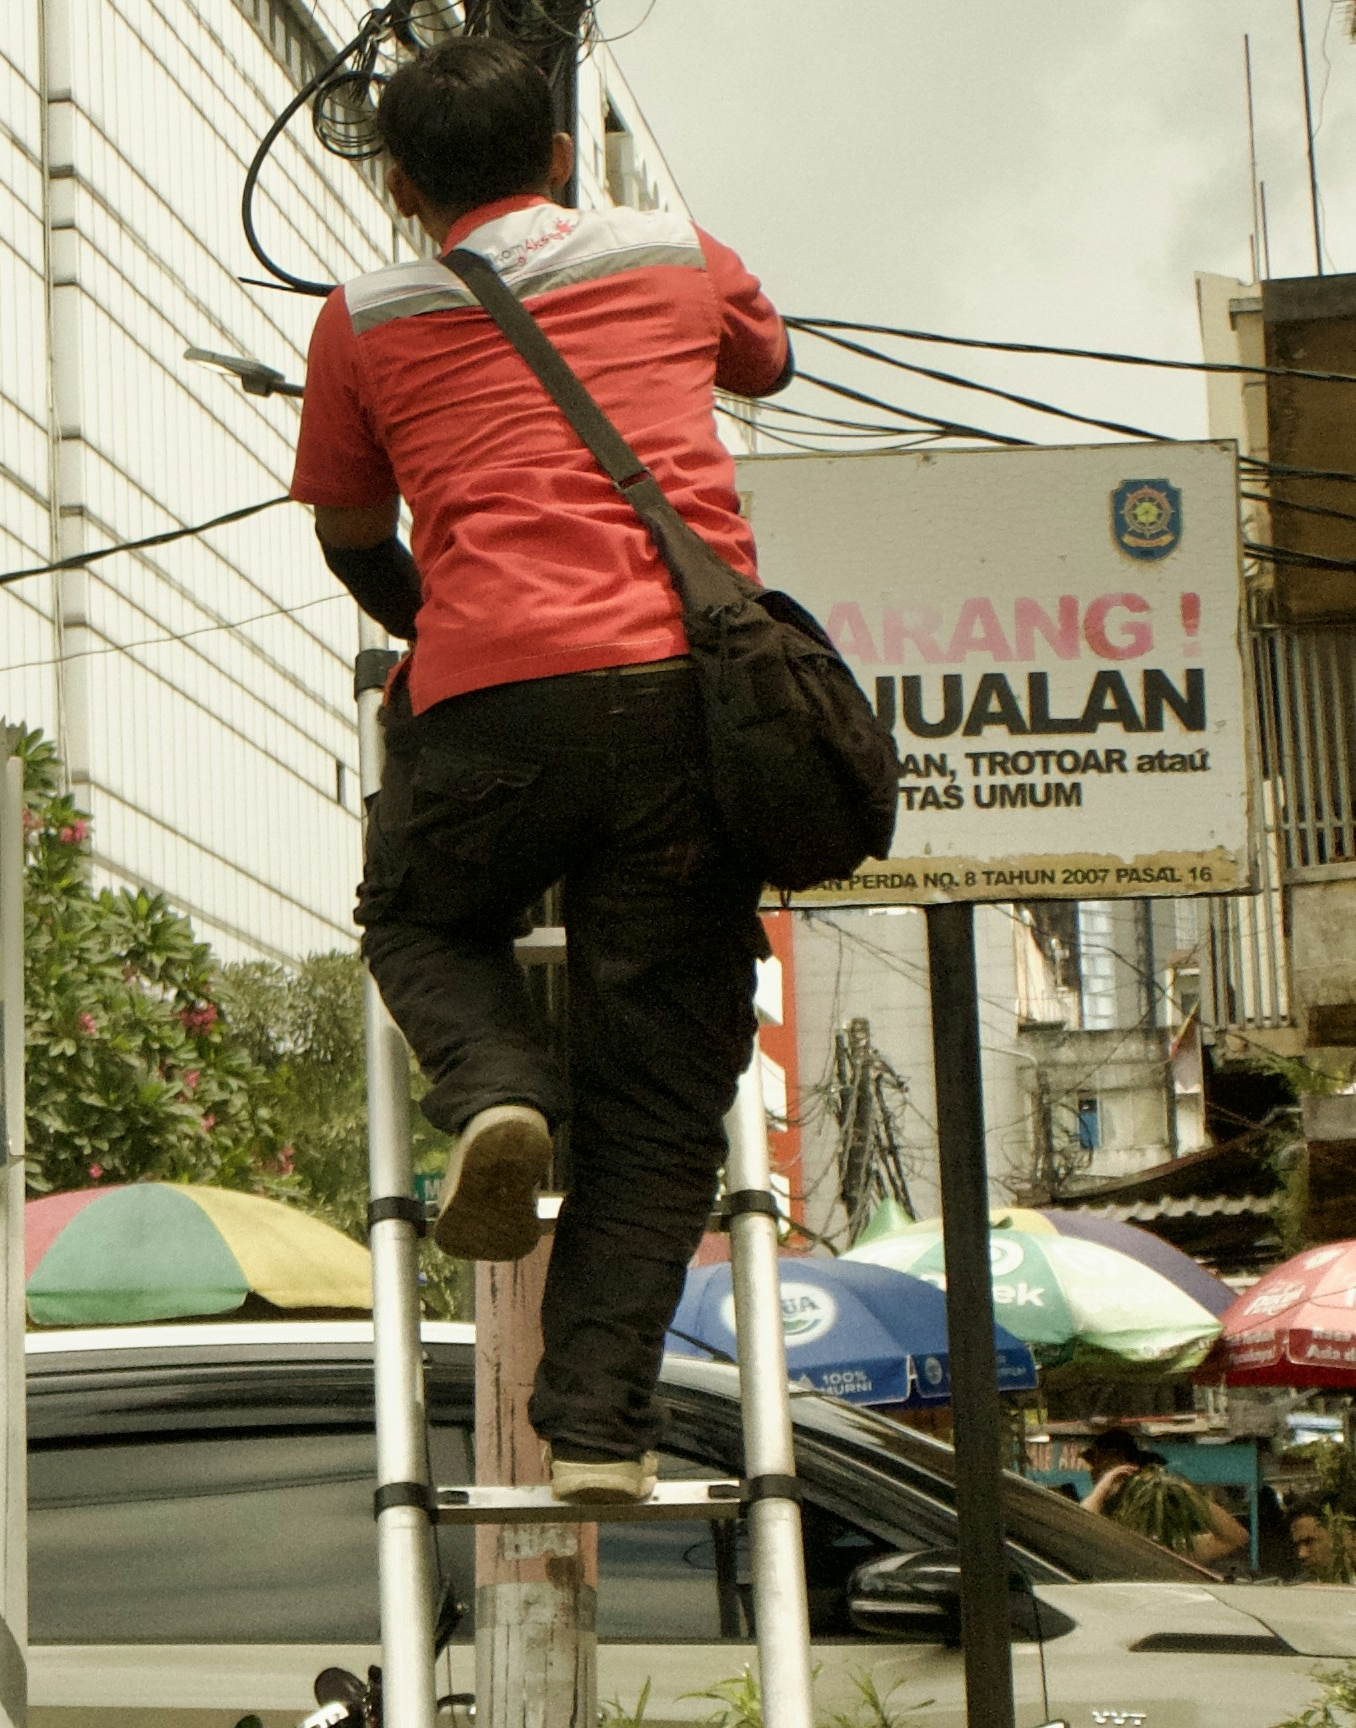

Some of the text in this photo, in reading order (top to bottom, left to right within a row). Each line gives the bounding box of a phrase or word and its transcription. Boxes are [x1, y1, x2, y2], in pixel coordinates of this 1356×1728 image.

[1179, 592, 1201, 658] !
[965, 748, 1127, 777] TROTOAR
[1136, 748, 1211, 773] atau
[973, 782, 1083, 810] UMUM
[849, 873, 918, 891] PERDA
[923, 872, 960, 890] NO.
[964, 871, 977, 887] 8
[982, 868, 1056, 886] TAHUN
[1061, 867, 1111, 885] 2007
[1115, 866, 1184, 884] PASAL
[1187, 866, 1213, 883] 16
[822, 1371, 869, 1389] 100%
